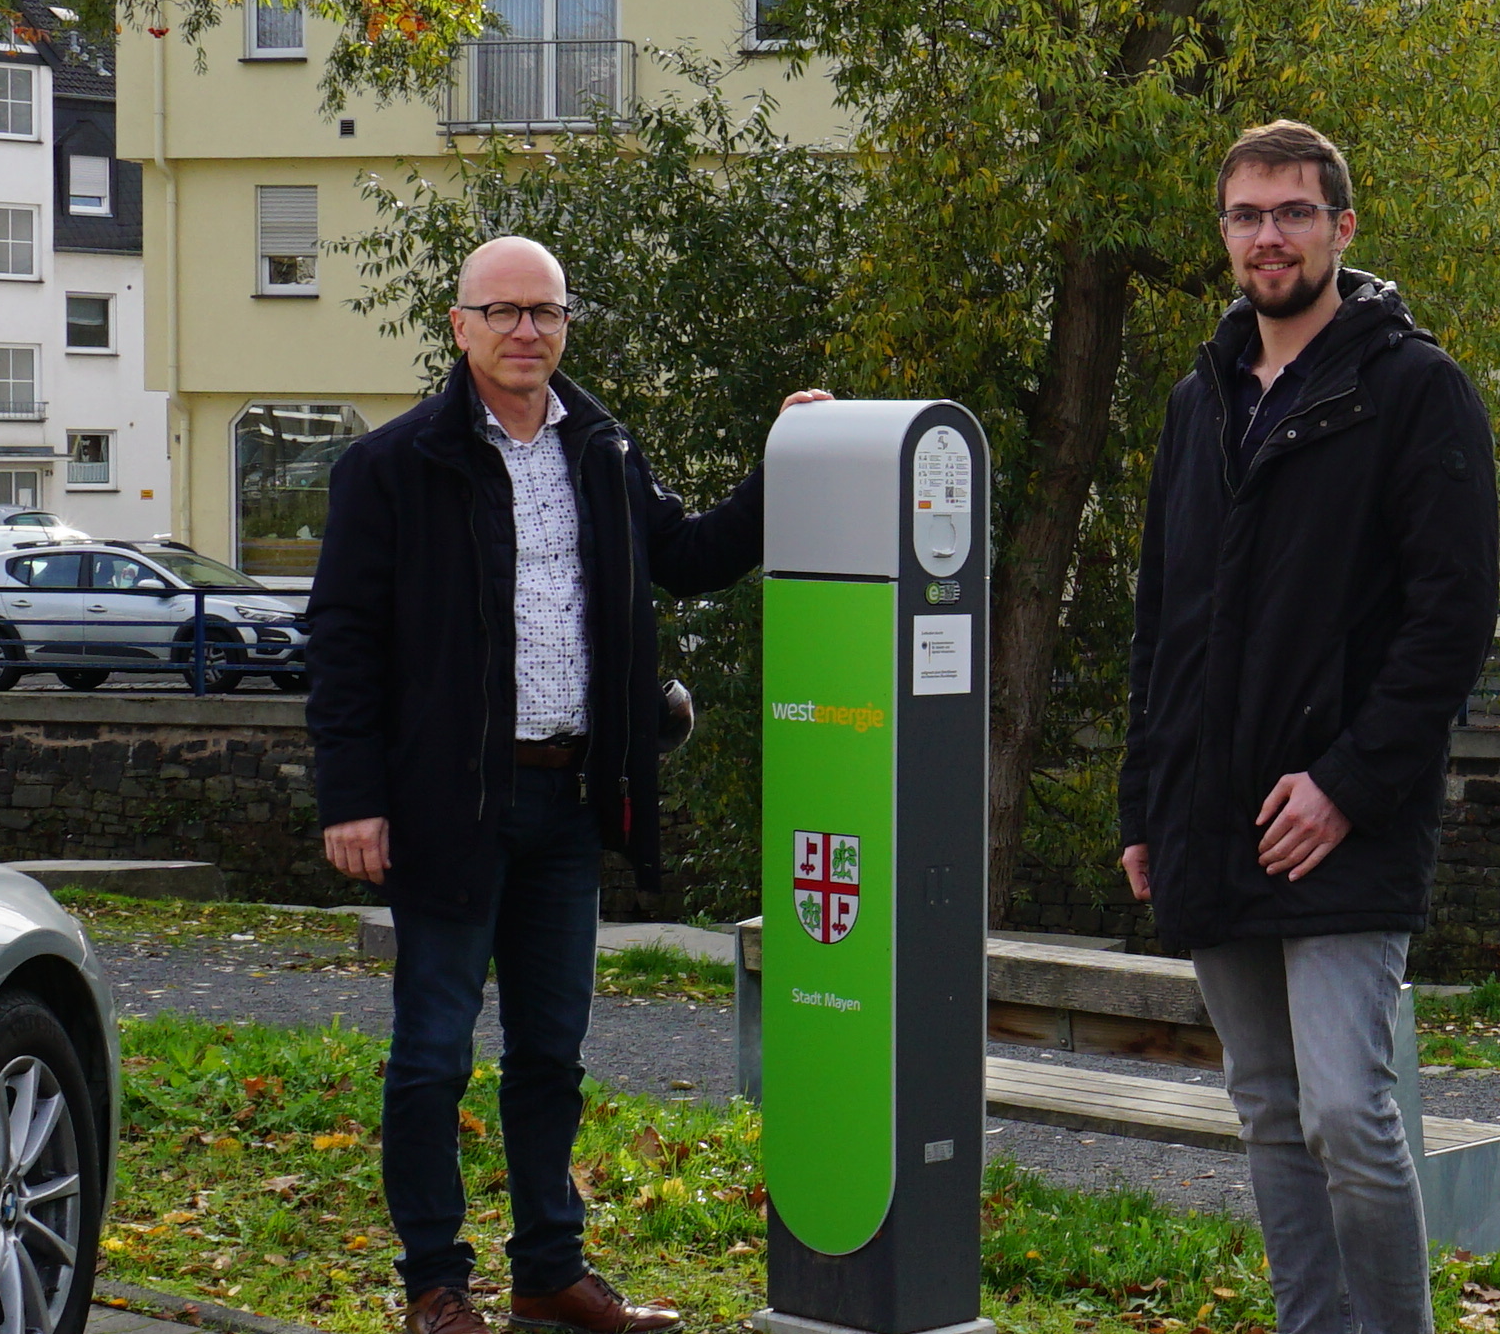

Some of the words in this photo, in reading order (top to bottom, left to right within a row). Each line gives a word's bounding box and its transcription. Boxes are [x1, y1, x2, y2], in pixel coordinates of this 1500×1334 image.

[771, 699, 885, 734] westenergie
[791, 987, 823, 1007] Stadt
[824, 992, 861, 1013] Mayen
